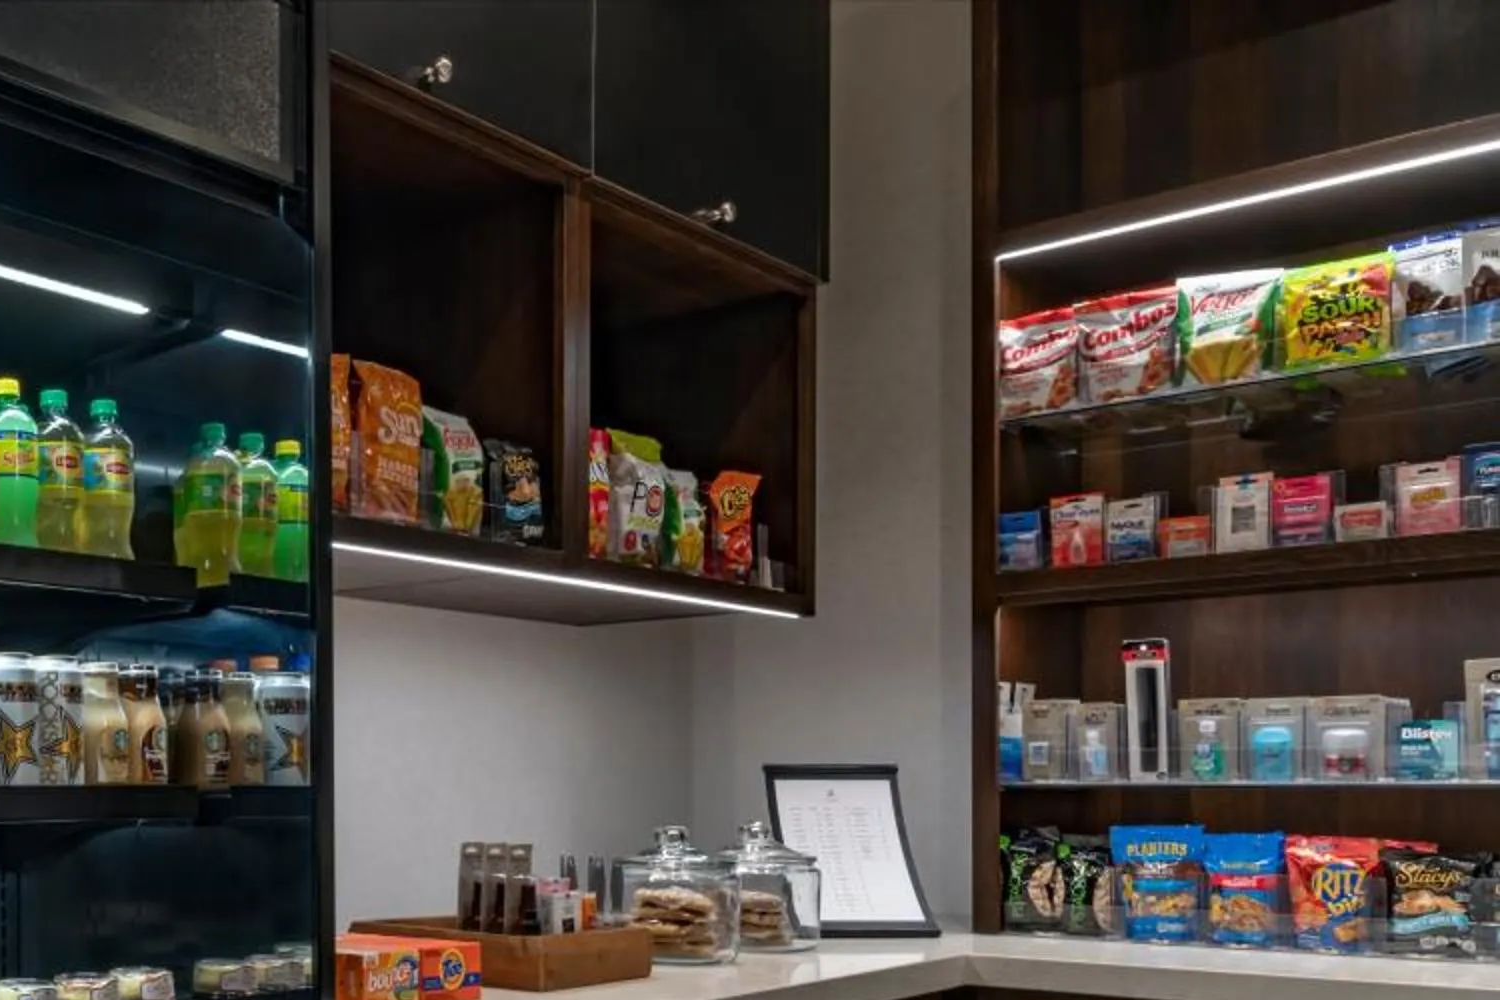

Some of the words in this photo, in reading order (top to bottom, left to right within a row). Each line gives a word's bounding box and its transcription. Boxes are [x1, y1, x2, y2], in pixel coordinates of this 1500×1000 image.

[1301, 294, 1376, 323] SOUR
[1083, 301, 1177, 351] Combos
[1126, 841, 1189, 857] PLANTERS
[1312, 863, 1368, 902] RITZ
